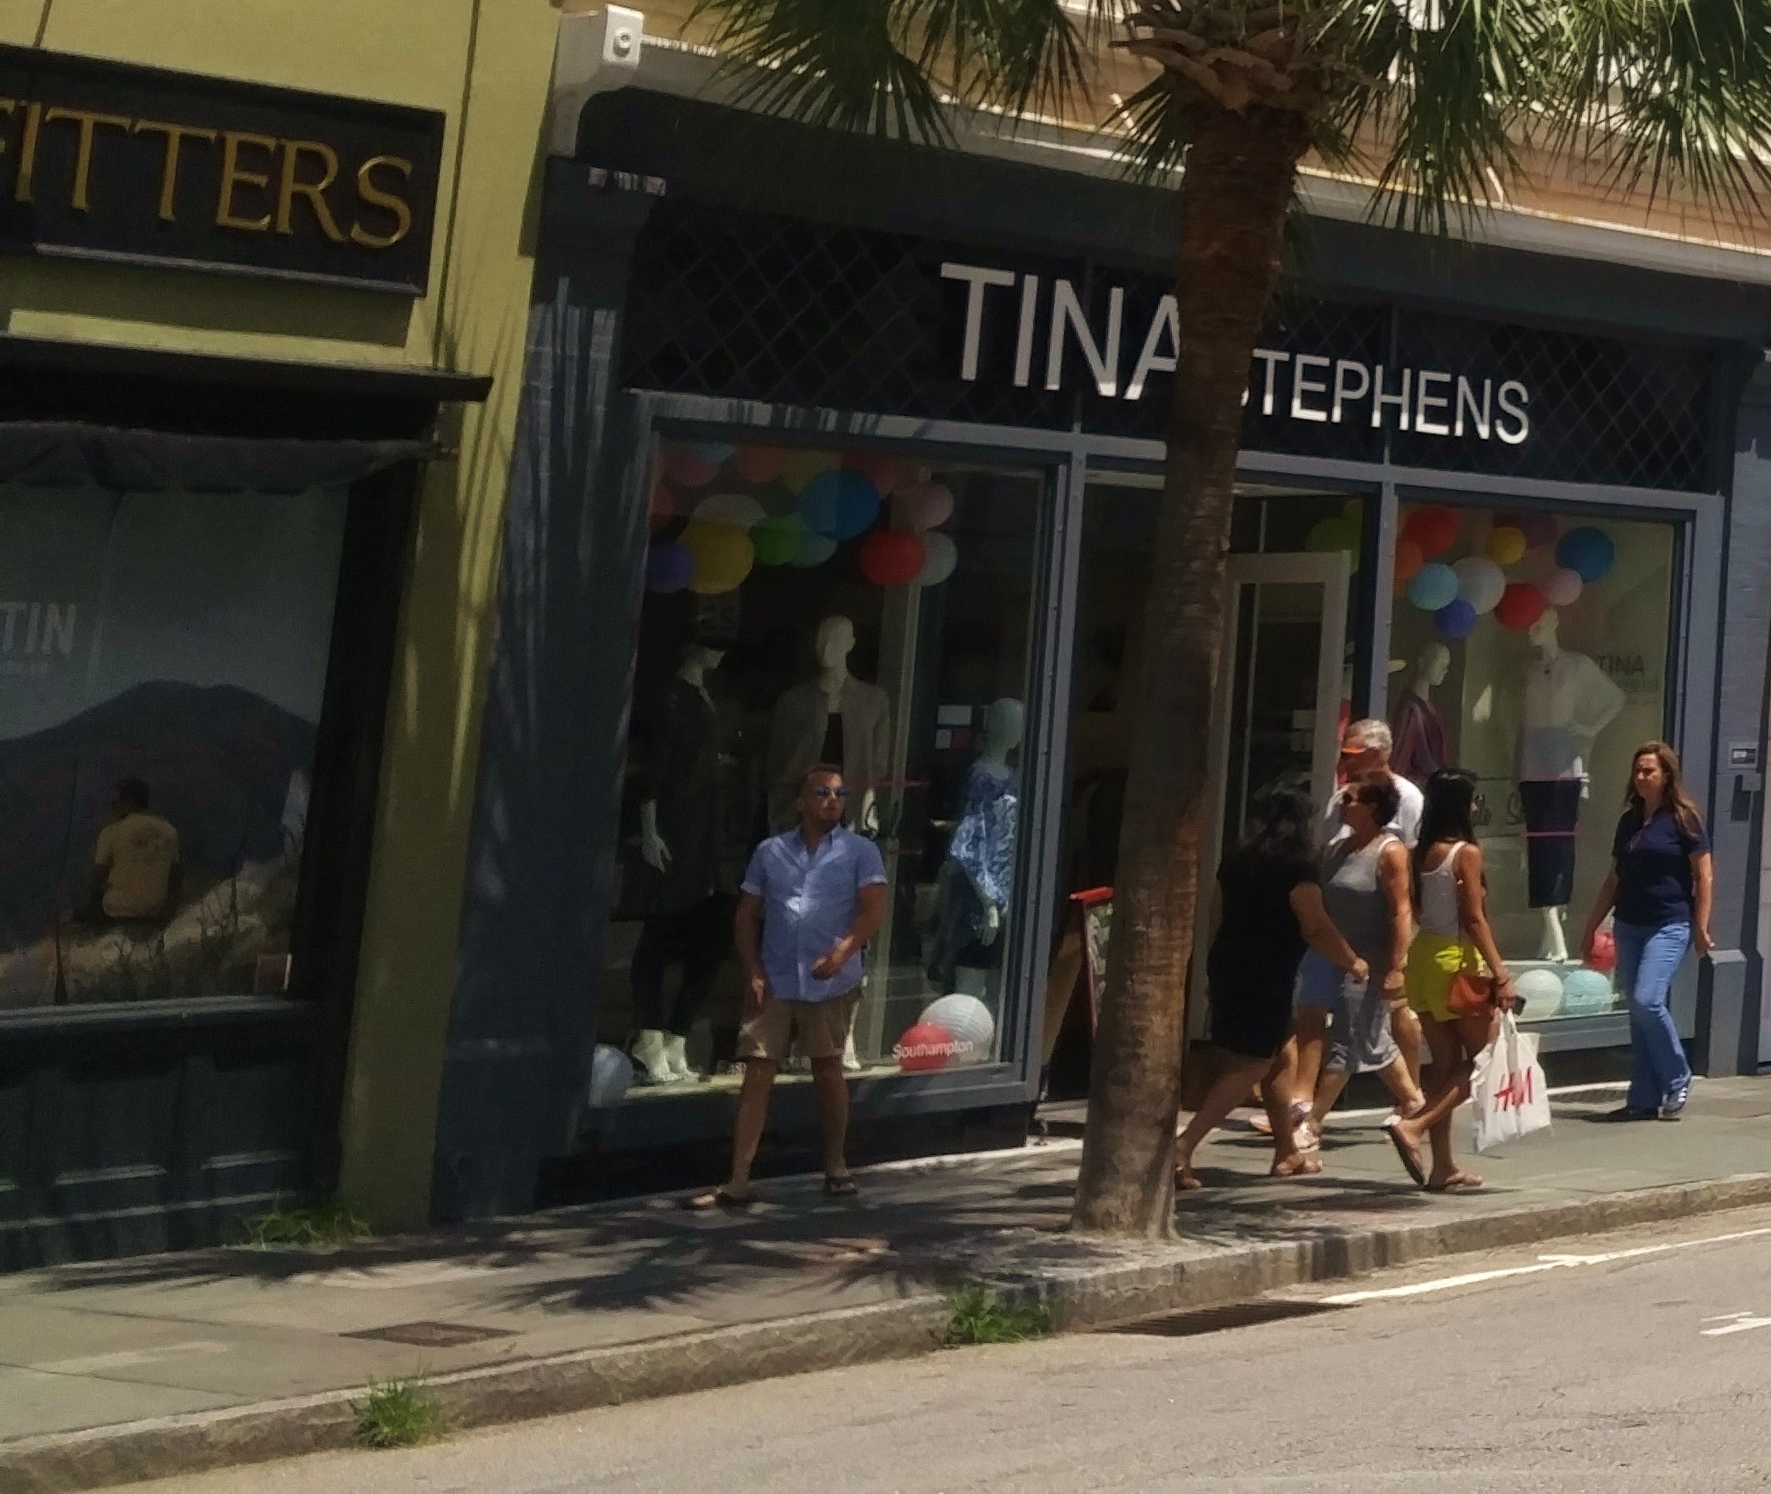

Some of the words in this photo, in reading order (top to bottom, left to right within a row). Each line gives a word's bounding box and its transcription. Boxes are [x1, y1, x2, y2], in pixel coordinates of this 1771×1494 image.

[0, 97, 413, 248] ITTERS
[940, 262, 1181, 401] TINA
[1240, 348, 1529, 444] TEPHENS
[892, 1040, 974, 1060] Southampton
